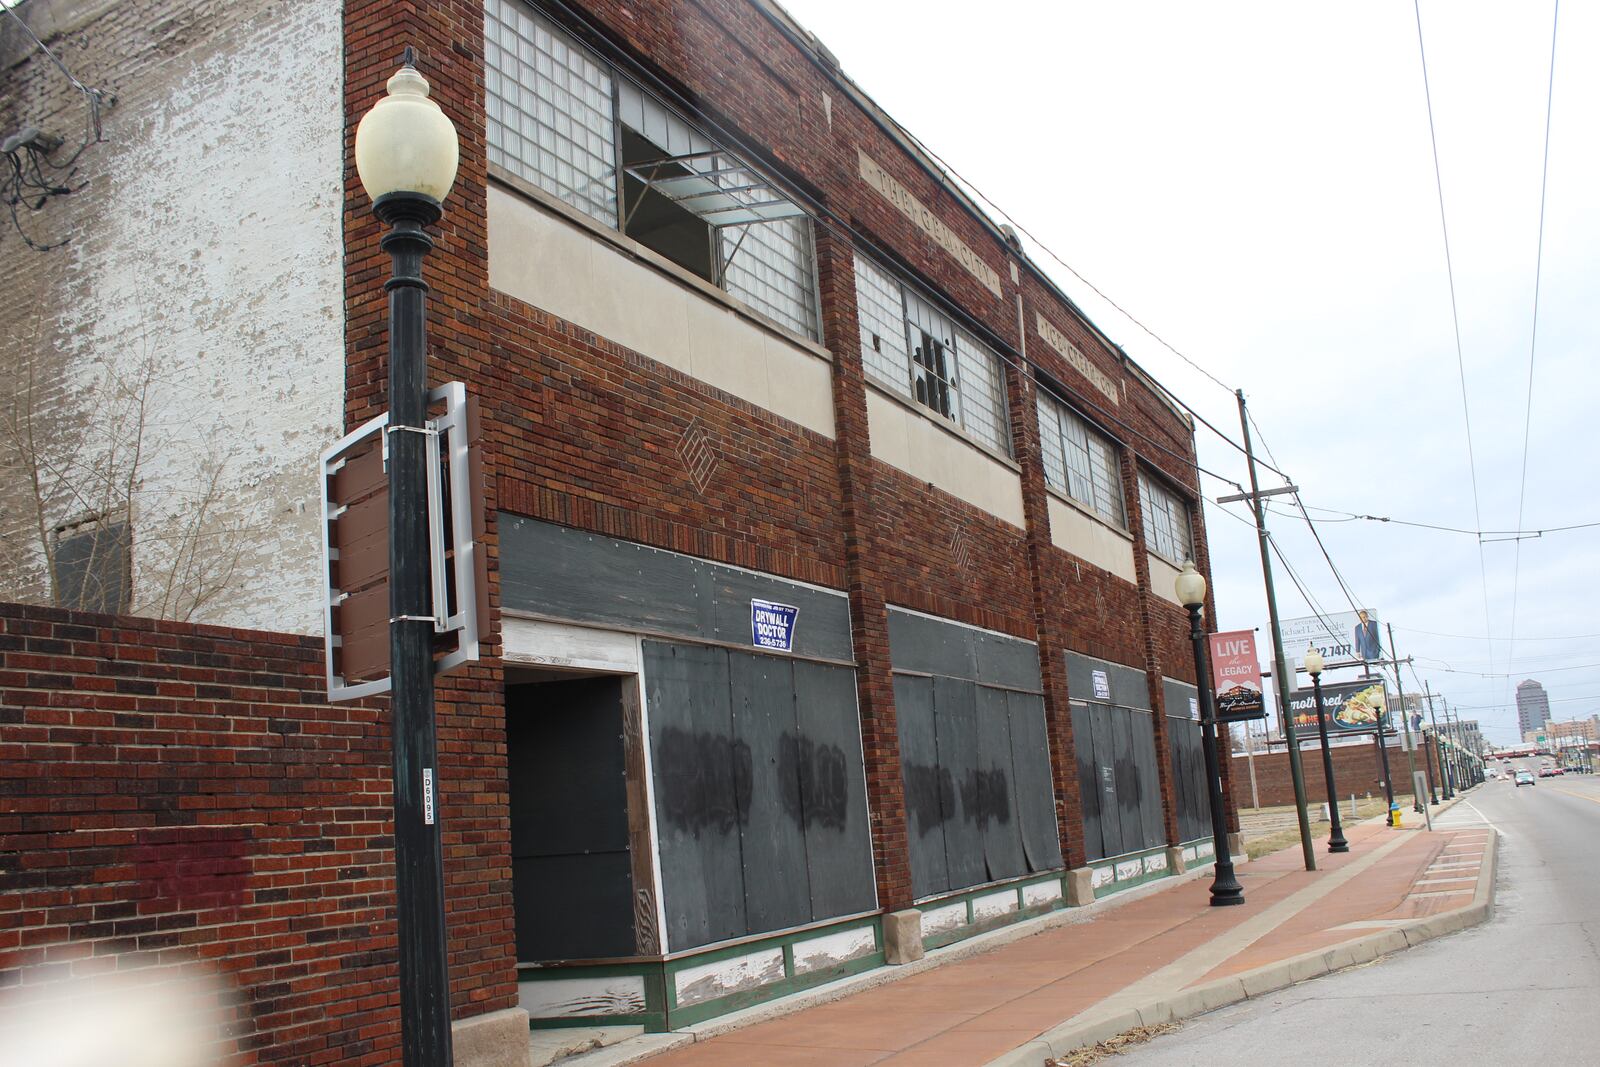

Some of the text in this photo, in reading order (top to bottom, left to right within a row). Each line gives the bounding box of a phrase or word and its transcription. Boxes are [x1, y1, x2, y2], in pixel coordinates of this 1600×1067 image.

[877, 169, 990, 285] THE GEM CITY
[1045, 322, 1063, 352] ICE
[756, 610, 789, 627] DRYWALL
[758, 623, 787, 639] DOCTOR
[1281, 626, 1305, 637] ichael
[1216, 640, 1251, 657] LIVE
[1228, 656, 1240, 665] the
[1220, 665, 1253, 676] LEGACY
[1290, 693, 1343, 710] mothred
[1307, 713, 1331, 723] HED
